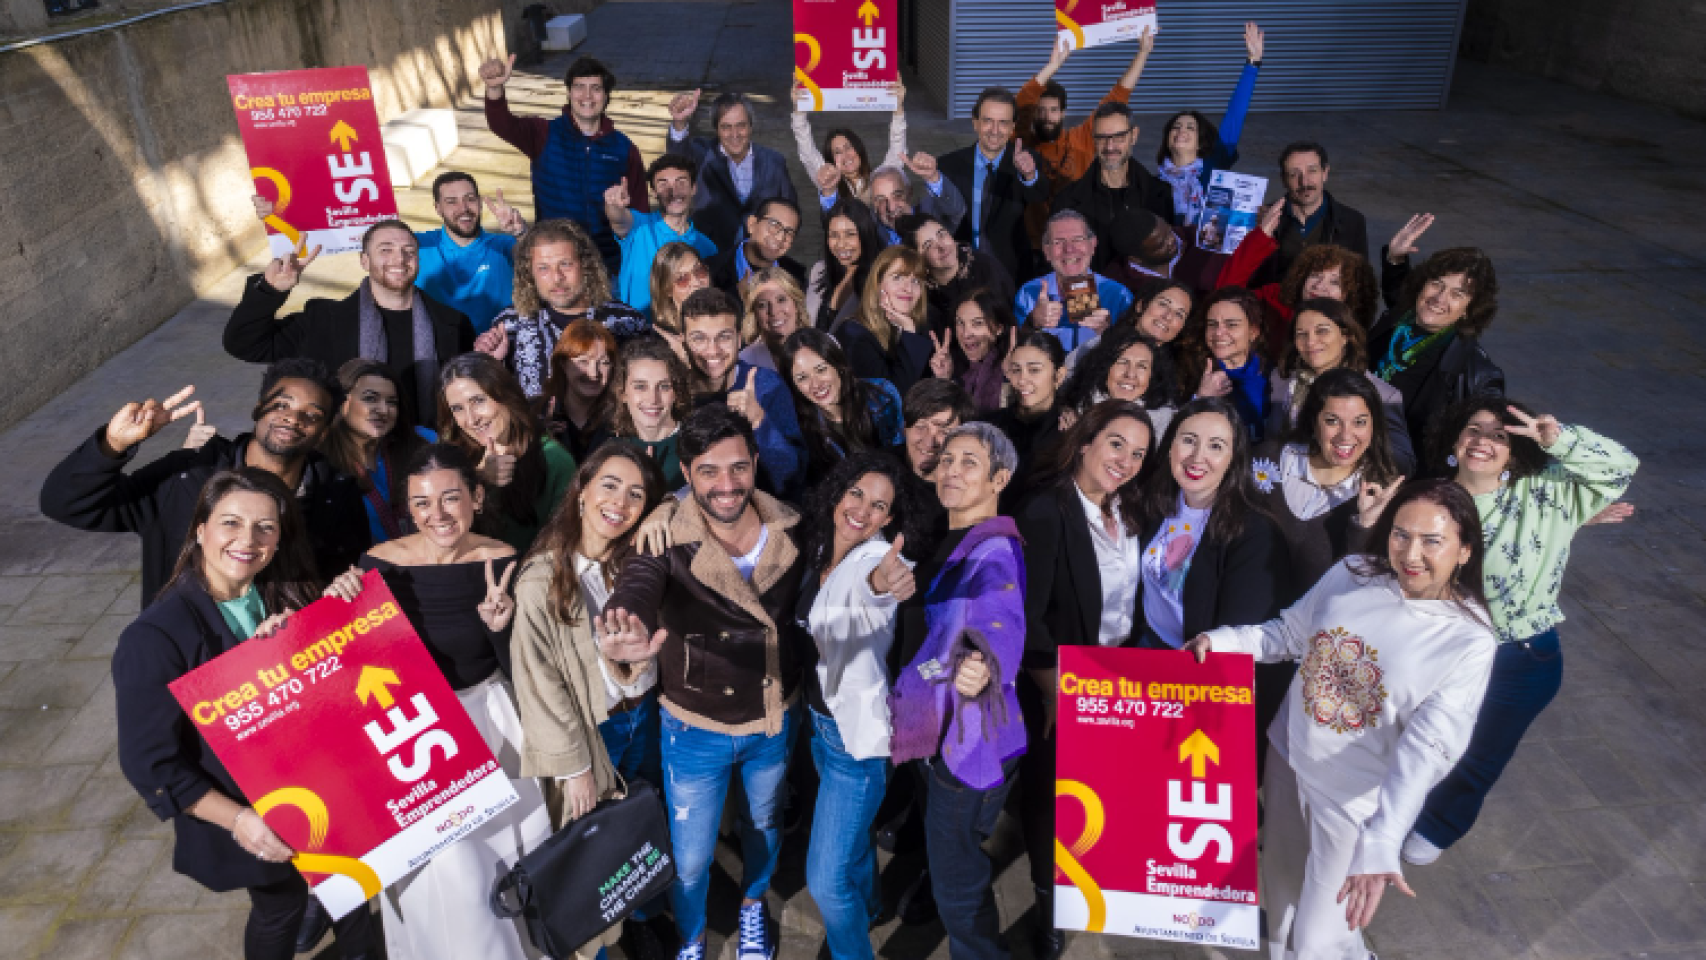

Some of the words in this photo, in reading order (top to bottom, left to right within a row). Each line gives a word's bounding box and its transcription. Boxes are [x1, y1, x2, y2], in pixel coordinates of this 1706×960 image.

[852, 27, 886, 69] SE
[235, 94, 275, 109] Crea
[278, 92, 295, 106] tu
[299, 88, 370, 106] empresa
[326, 151, 379, 204] SE
[192, 680, 259, 725] Crea
[256, 663, 290, 689] tu
[291, 600, 401, 671] empresa
[224, 702, 263, 731] 955
[268, 677, 303, 707] 470
[303, 656, 343, 684] 722
[1059, 673, 1113, 697] Crea
[1118, 676, 1141, 698] tu
[1147, 681, 1253, 705] empresa
[1077, 697, 1108, 713] 955
[1113, 699, 1146, 716] 470
[1150, 702, 1184, 718] 722
[235, 701, 300, 741] www.sevilla.org
[362, 692, 459, 782] SE
[385, 779, 438, 811] Sevilla
[391, 760, 497, 827] Emprendedora
[1167, 779, 1233, 863] SE
[598, 861, 632, 895] MAKE
[630, 840, 653, 863] THE
[600, 863, 646, 910] CHANGE
[602, 899, 626, 922] THE
[625, 853, 670, 901] CHANGE
[1146, 858, 1197, 879] Sevilla
[1146, 876, 1255, 902] Emprendedora
